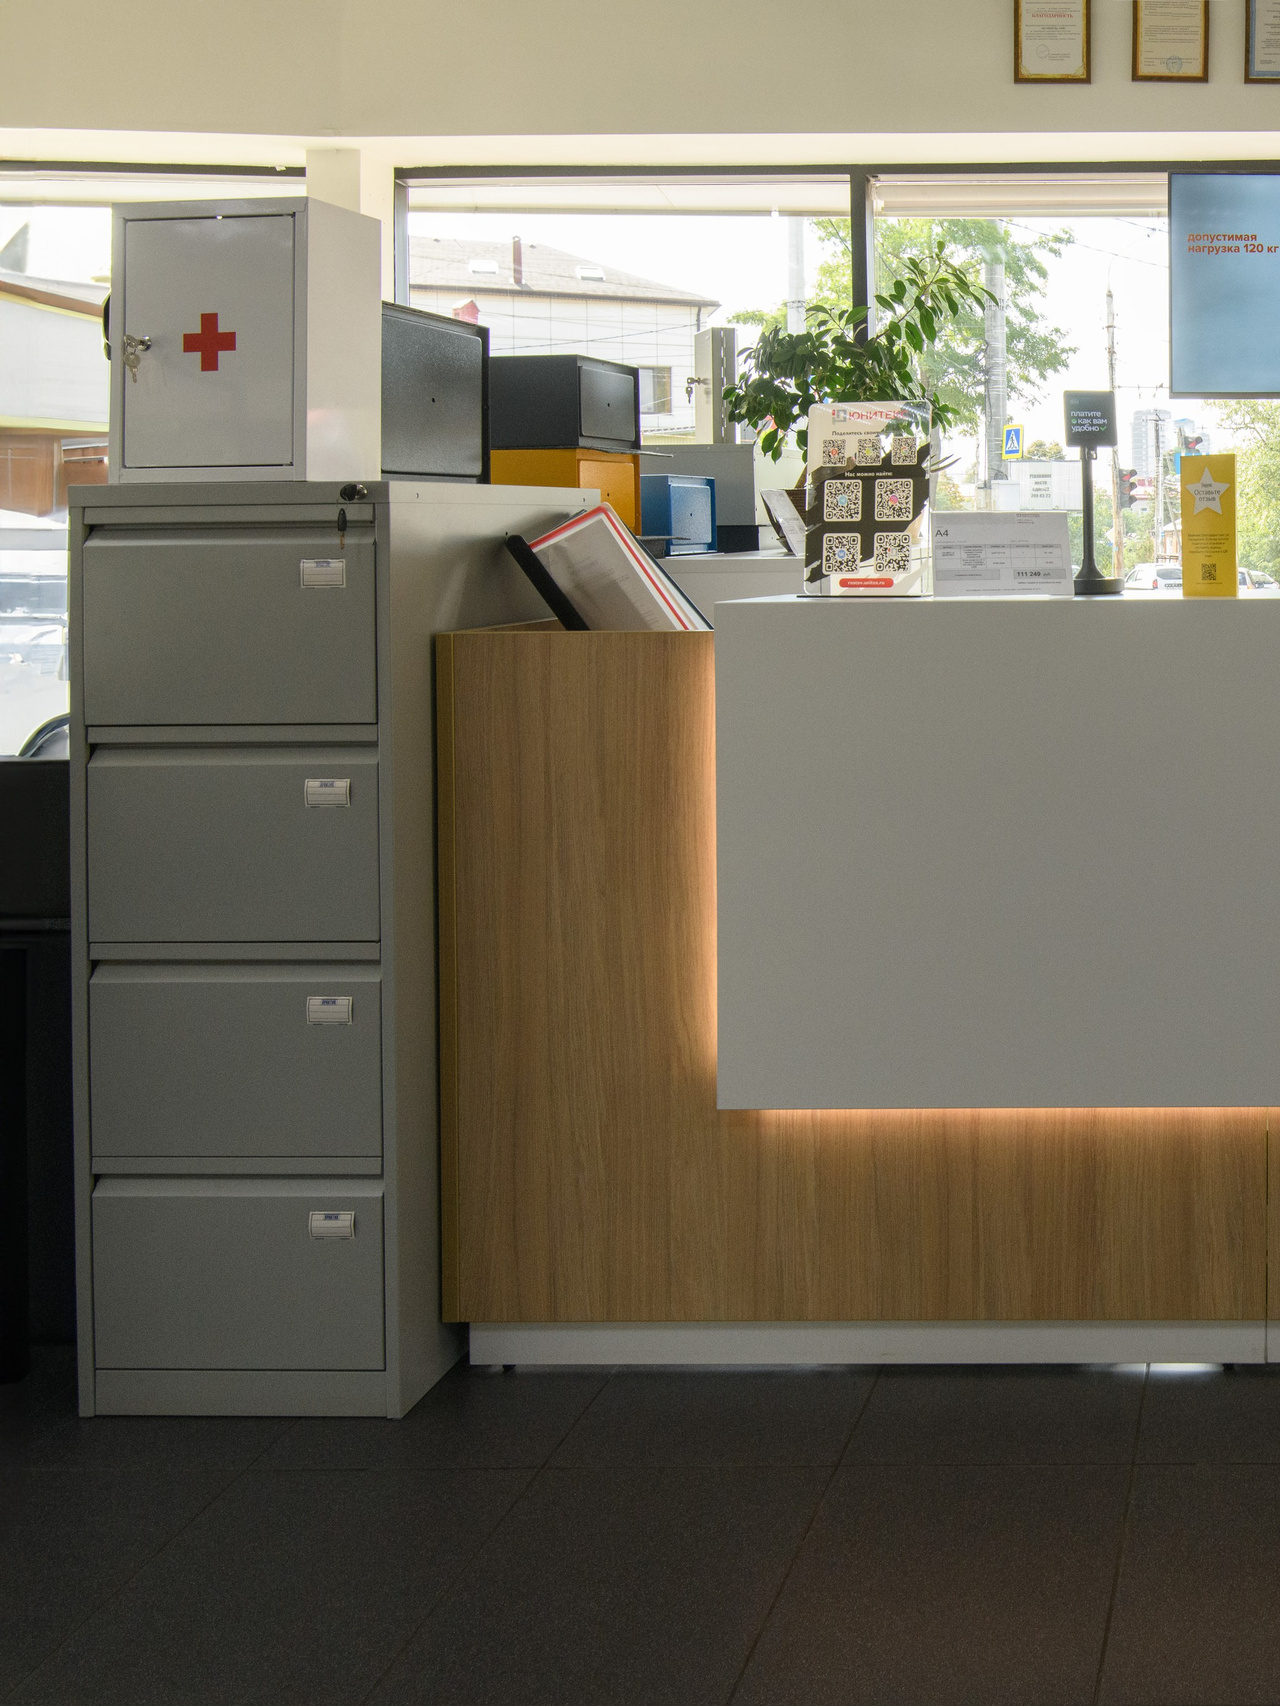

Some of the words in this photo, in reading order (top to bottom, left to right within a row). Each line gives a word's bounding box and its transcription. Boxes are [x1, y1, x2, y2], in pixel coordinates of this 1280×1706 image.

[1187, 233, 1257, 243] допустимая
[1187, 244, 1240, 255] нагрузка
[1243, 244, 1264, 253] 120
[1267, 245, 1279, 253] кг
[848, 410, 909, 421] ЮНИТЕКС
[1071, 424, 1100, 433] удобно
